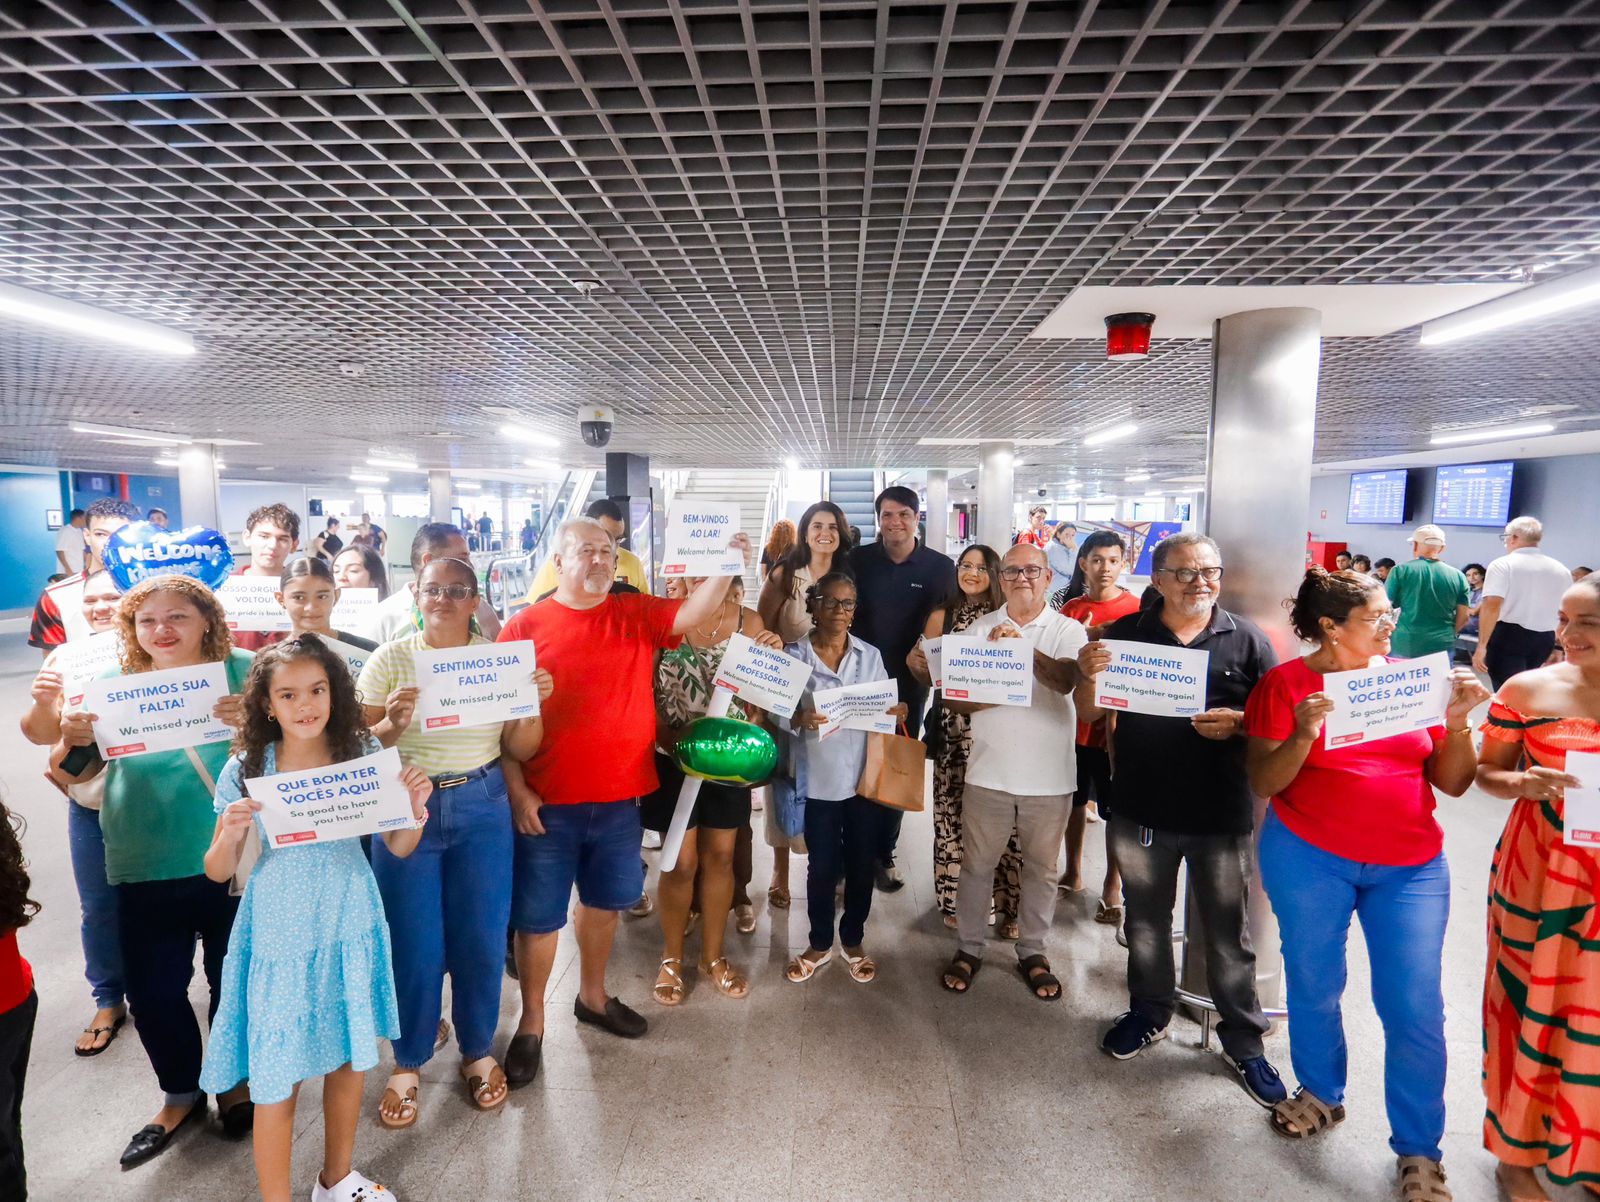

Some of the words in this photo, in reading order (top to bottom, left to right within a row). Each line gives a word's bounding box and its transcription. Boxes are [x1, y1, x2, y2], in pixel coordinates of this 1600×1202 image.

[683, 514, 729, 524] BEM-VINDOS
[690, 529, 702, 538] AO
[703, 529, 721, 538] LAR!
[677, 548, 706, 556] Welcome
[707, 547, 728, 555] home!
[748, 645, 791, 667] BEM-VINDOS
[960, 648, 1013, 658] FINALMENTE
[432, 658, 493, 674] SENTIMOS
[496, 655, 520, 666] SUA
[751, 658, 764, 667] AO
[948, 659, 980, 668] JUNTOS
[982, 660, 993, 669] DE
[995, 662, 1025, 671] NOVO!
[1120, 653, 1183, 670] FINALMENTE
[458, 672, 497, 686] FALTA!
[723, 670, 749, 684] Welcome
[736, 663, 790, 688] PROFESSORES!
[949, 675, 969, 684] Finally
[971, 676, 1000, 685] together
[1105, 665, 1143, 677] JUNTOS
[1145, 670, 1158, 679] DE
[1160, 672, 1197, 685] NOVO!
[1347, 678, 1373, 691] QUE
[1377, 672, 1407, 685] BOM
[1409, 667, 1431, 679] TER
[107, 683, 178, 703] SENTIMOS
[182, 678, 210, 691] SUA
[843, 692, 894, 701] INTERCAMBISTA
[1104, 682, 1130, 693] Finally
[1131, 687, 1166, 697] together
[1168, 692, 1195, 701] again!
[1394, 682, 1430, 697] AQUI!
[139, 698, 185, 714] FALTA!
[440, 698, 456, 707] We
[459, 693, 494, 705] missed
[496, 689, 518, 702] you!
[1364, 706, 1387, 717] good
[1401, 701, 1424, 709] have
[119, 724, 139, 736] We
[142, 718, 182, 733] missed
[185, 714, 211, 728] you!
[1366, 719, 1383, 727] you
[1384, 712, 1409, 722] here!
[277, 779, 309, 793] QUE
[312, 773, 348, 786] BOM
[351, 766, 377, 779] TER
[281, 788, 334, 805] VOCÊS
[338, 780, 381, 797] AQUI!
[290, 810, 302, 818] So
[307, 805, 335, 818] good
[338, 803, 349, 811] to
[351, 799, 378, 809] have
[313, 818, 333, 827] you
[335, 812, 364, 823] here!
